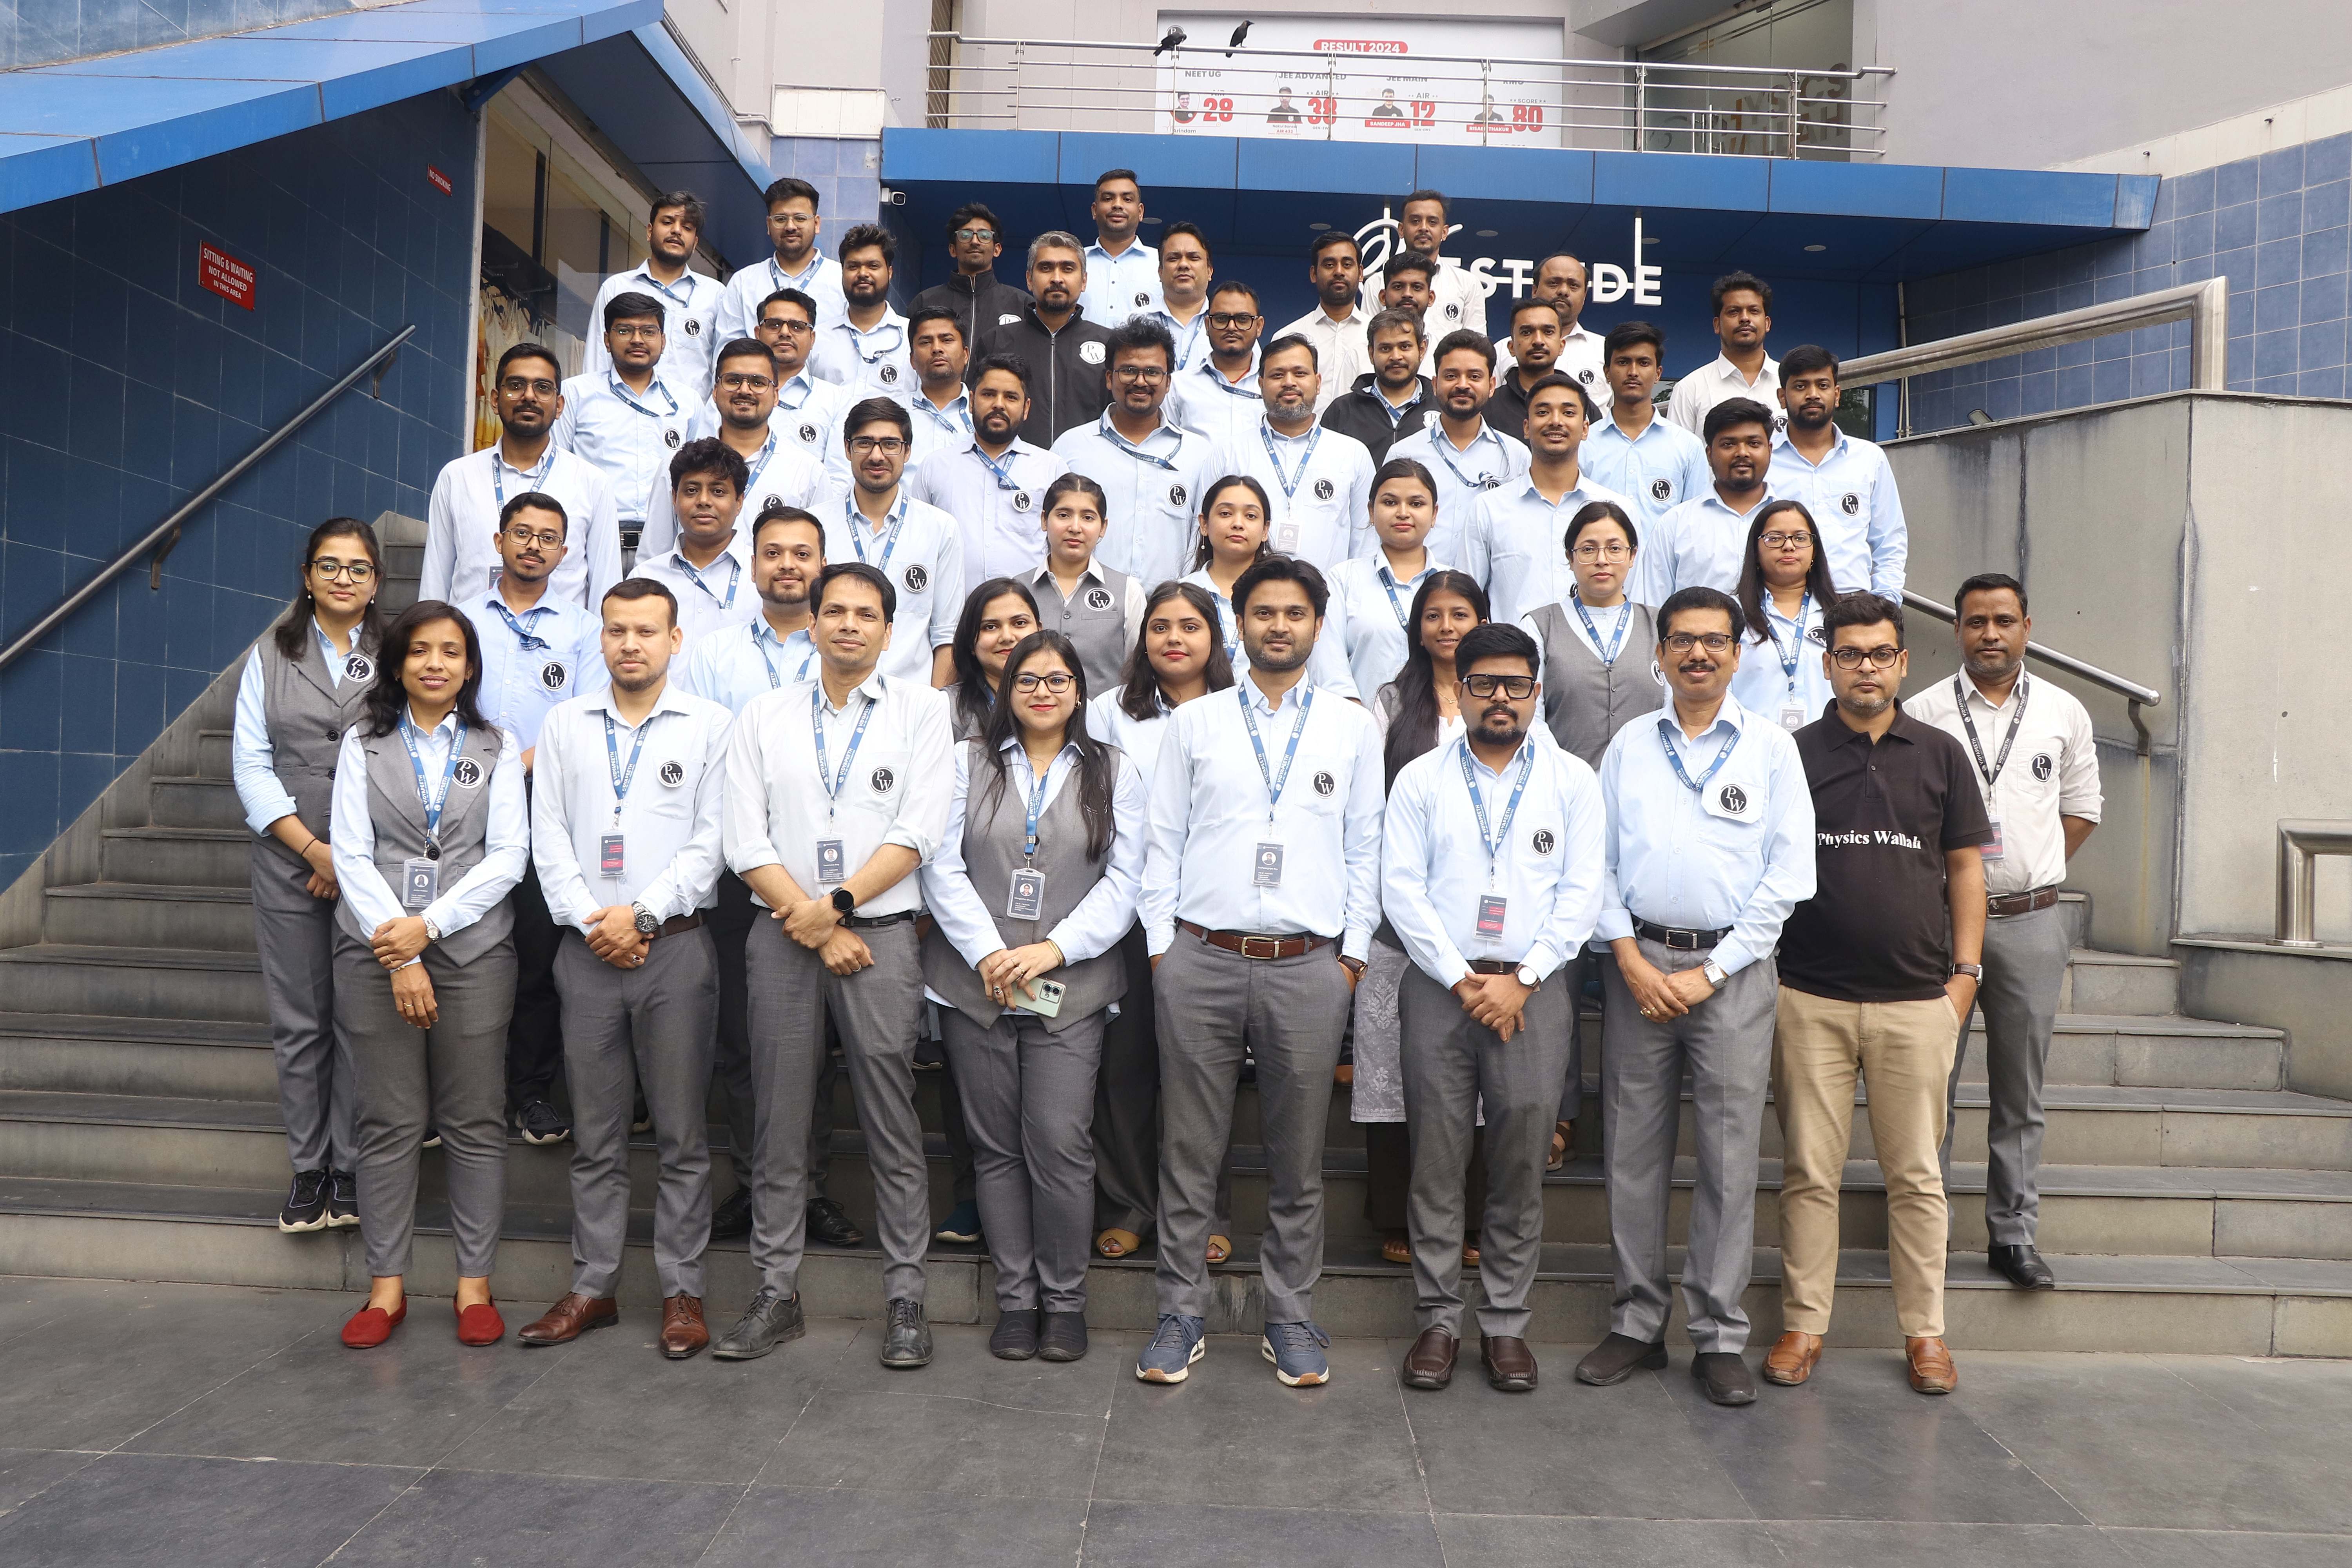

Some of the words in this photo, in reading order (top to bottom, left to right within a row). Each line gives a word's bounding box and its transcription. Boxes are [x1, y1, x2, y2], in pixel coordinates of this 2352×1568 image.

[1321, 42, 1366, 51] RESULT
[1369, 43, 1400, 53] 2024
[1203, 98, 1233, 122] 28
[1308, 97, 1337, 124] 38
[1410, 101, 1436, 127] 12
[1513, 105, 1543, 132] 80
[204, 248, 224, 268] SITTING
[225, 260, 229, 270] &
[231, 262, 253, 283] WAITING
[209, 265, 220, 278] NOT
[221, 272, 247, 291] ALLOWED
[220, 283, 229, 292] THIS
[230, 289, 241, 299] AREA
[535, 466, 548, 486] VIDYAPEETH
[859, 703, 871, 727] VIDYAPEETH
[1243, 705, 1254, 732] VIDYAPEETH
[1294, 706, 1305, 731] VIDYAPEETH
[2015, 694, 2026, 717] VIDYAPEETH
[452, 729, 463, 753] VIDYAPEETH
[1722, 730, 1738, 751] VIDYAPEET
[1971, 738, 1982, 765] VIDYAPEETH
[1998, 738, 2010, 763] VIDYAPEETH
[839, 748, 853, 775] VIDYAPEETH
[1257, 753, 1269, 783] VIDYAPEETH
[1277, 754, 1289, 783] VIDYAPEETH
[1461, 756, 1471, 782] VIDYAPEETH
[1517, 757, 1530, 784] VIDYAPEETH
[418, 775, 427, 804] VIDYAPEETH
[436, 776, 448, 804] VIDYAPEETH
[1475, 805, 1486, 834] VIDYAPEETH
[1498, 807, 1511, 837] VIDYAPEETH
[1817, 830, 1869, 848] Physics
[1873, 831, 1921, 849] Wallah
